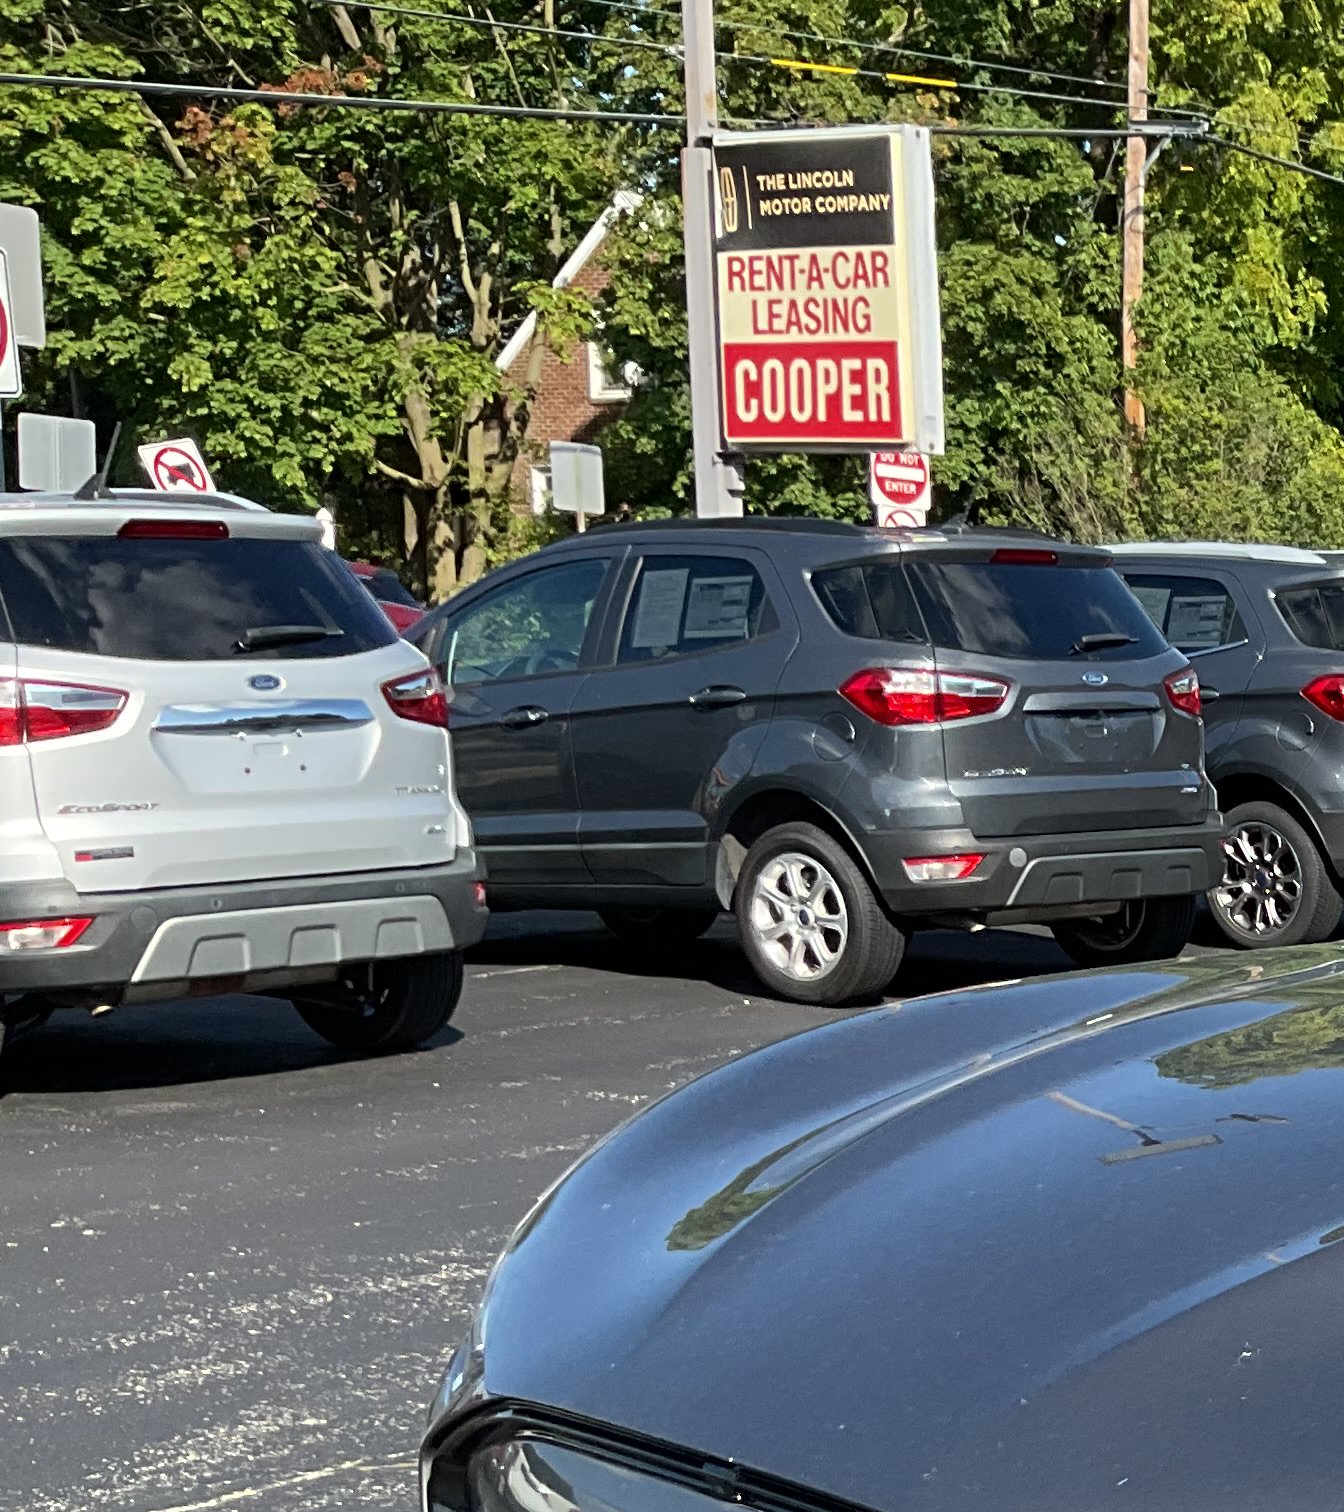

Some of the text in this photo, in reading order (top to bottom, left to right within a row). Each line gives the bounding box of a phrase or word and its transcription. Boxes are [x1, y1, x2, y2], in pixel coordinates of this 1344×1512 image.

[756, 169, 854, 191] THE LINCOLN
[759, 193, 891, 216] MOTOR COMPANY
[727, 250, 890, 292] RENT-A-CAR
[751, 295, 872, 336] LEASING
[734, 357, 891, 424] COOPER
[880, 452, 920, 467] DO NOT
[884, 480, 917, 495] ENTER
